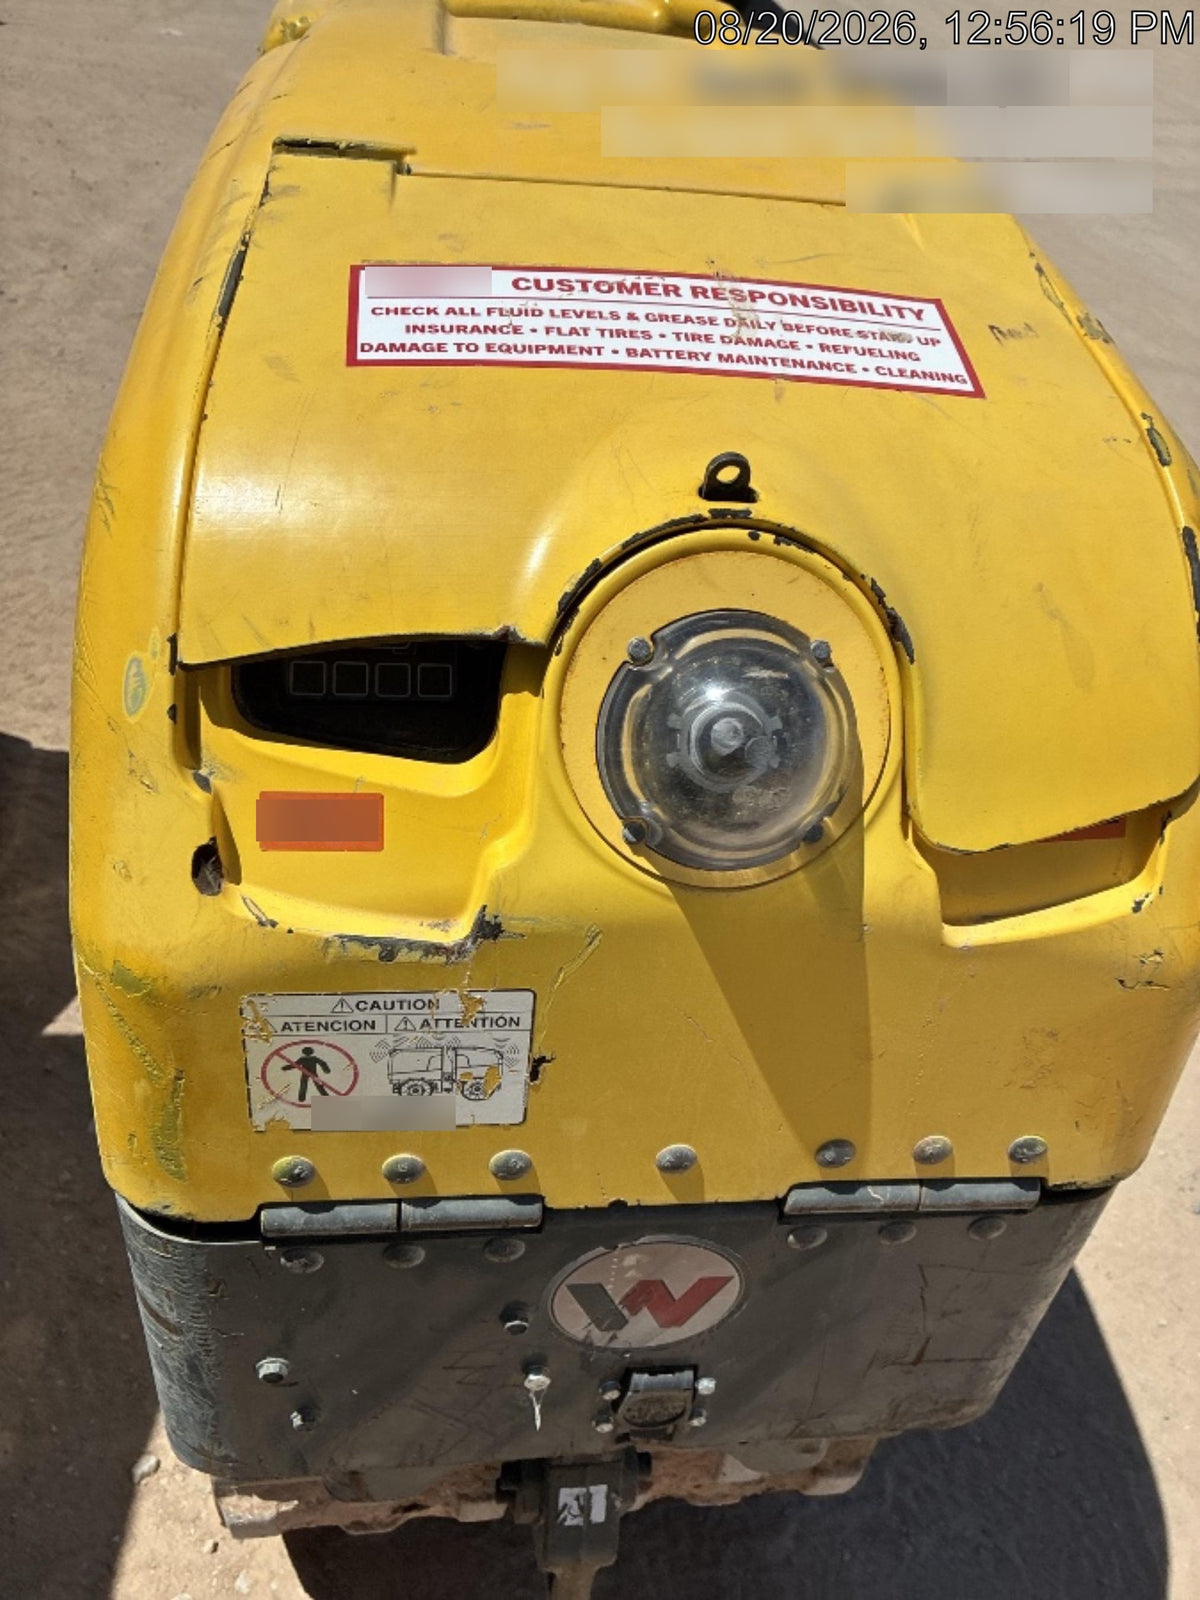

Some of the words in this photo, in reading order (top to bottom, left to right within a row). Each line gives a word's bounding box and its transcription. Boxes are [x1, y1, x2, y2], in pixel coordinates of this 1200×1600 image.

[511, 277, 682, 297] CUSTOMER
[690, 285, 924, 321] RESPONSIBILITY
[371, 306, 440, 317] CHECK
[444, 306, 481, 317] ALL
[486, 307, 543, 318] FLUID
[549, 308, 620, 321] LEVELS
[626, 311, 639, 321] &
[645, 312, 719, 326] GREASE
[723, 317, 776, 331] DAILY
[781, 322, 854, 339] BEFORE
[917, 335, 941, 347] UP
[405, 324, 524, 336] INSURANCE
[544, 325, 589, 337] FLAT
[597, 327, 652, 340] TIRES
[672, 331, 715, 343] TIRE
[720, 335, 801, 350] DAMAGE
[819, 342, 921, 362] REFUELING
[360, 342, 448, 353] DAMAGE
[453, 342, 479, 353] TO
[485, 342, 604, 356] EQUIPMENT
[626, 347, 711, 362] BATTERY
[718, 353, 857, 374] MAINTENANCE
[875, 365, 968, 385] CLEANING
[355, 998, 440, 1011] CAUTION
[281, 1019, 376, 1032] ATENCION
